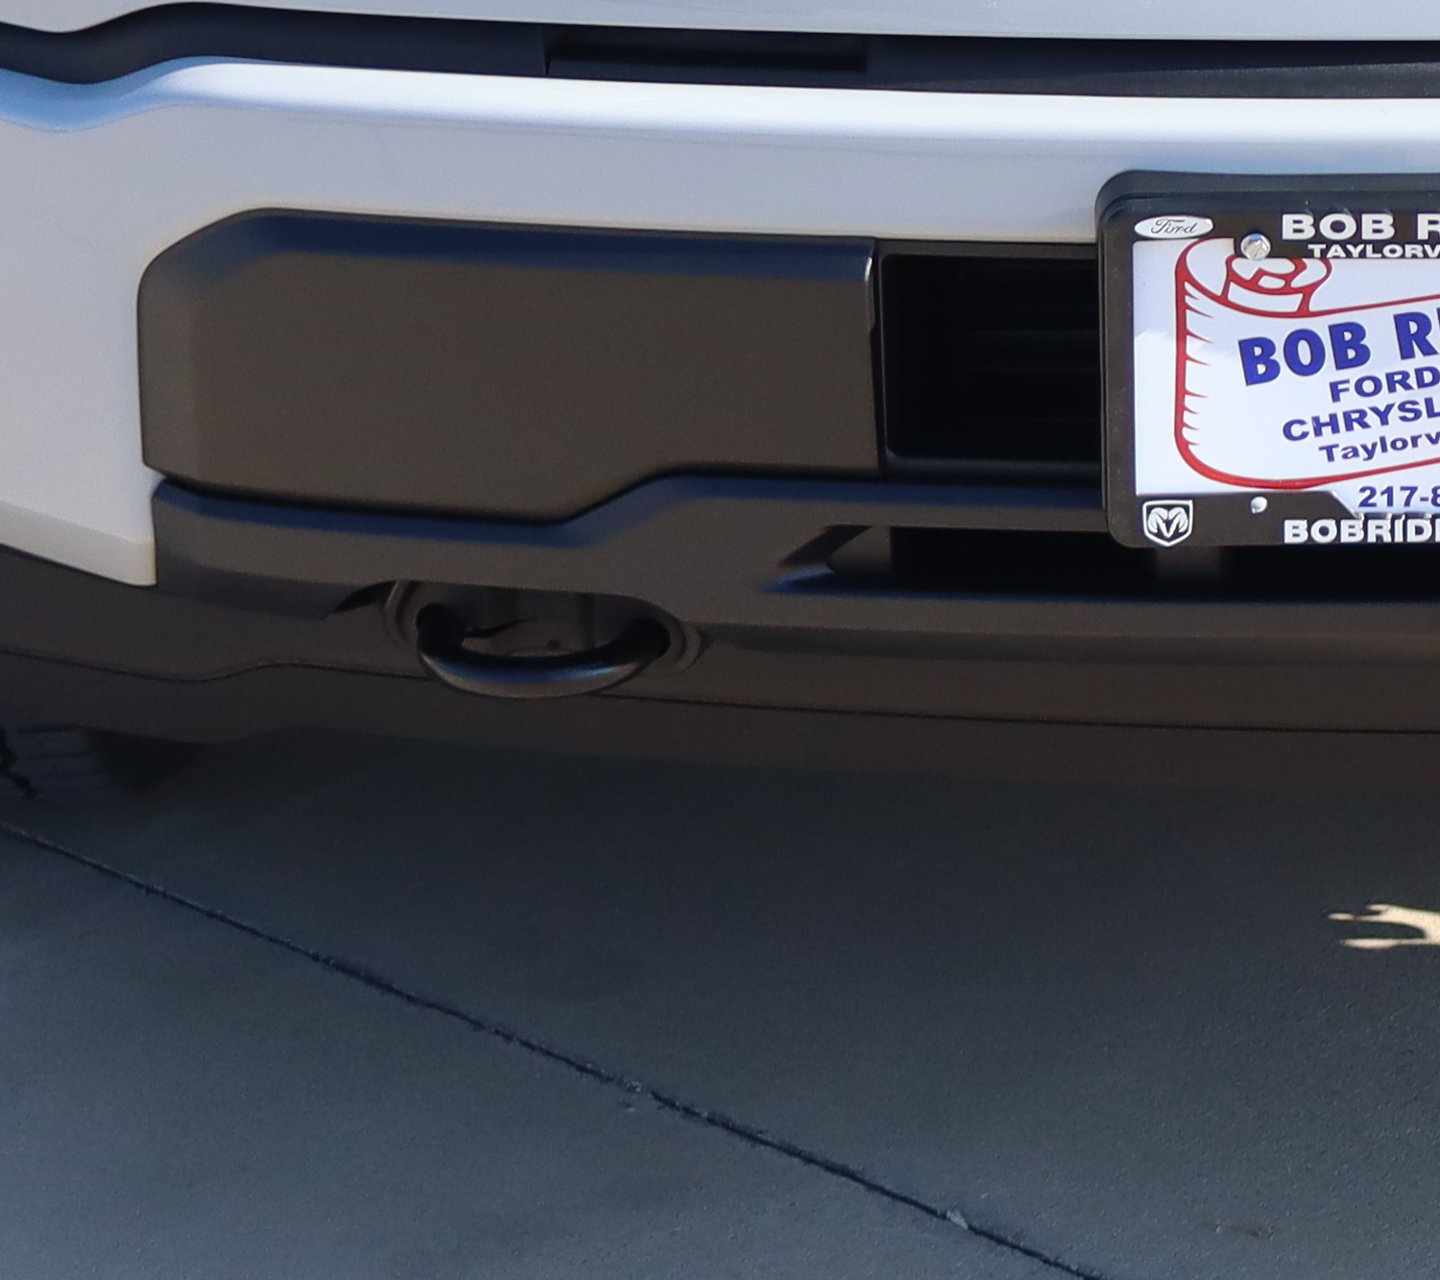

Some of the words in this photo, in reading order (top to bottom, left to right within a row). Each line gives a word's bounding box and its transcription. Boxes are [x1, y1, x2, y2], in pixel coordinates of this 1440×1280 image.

[1151, 219, 1198, 234] Ford
[1281, 213, 1396, 240] BOB
[1238, 321, 1372, 387] BOB
